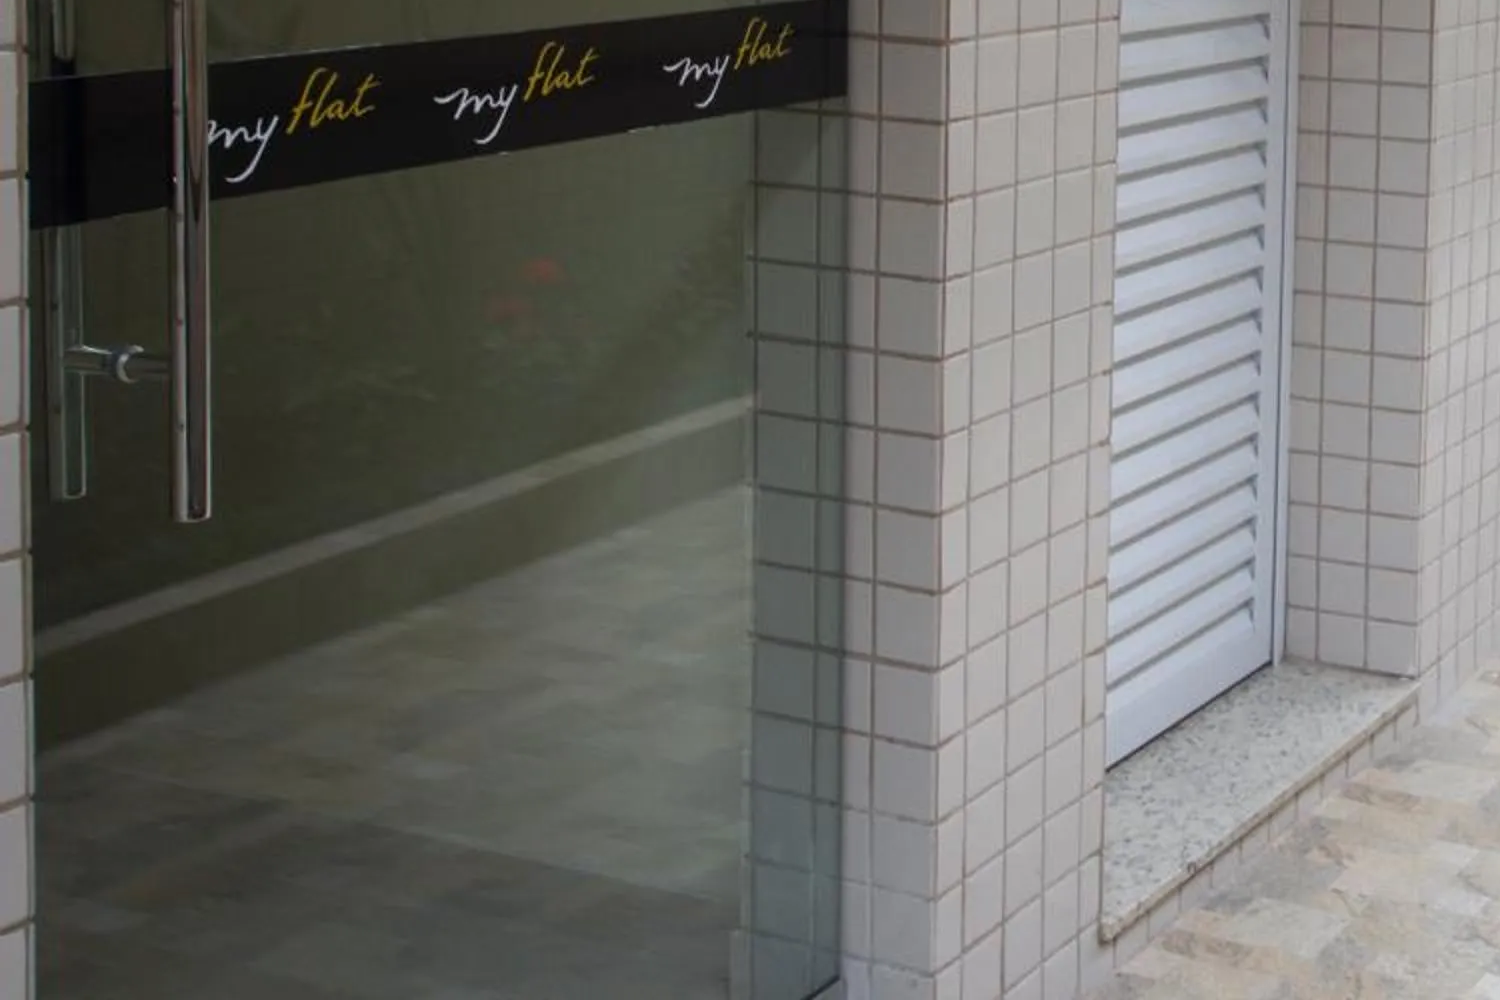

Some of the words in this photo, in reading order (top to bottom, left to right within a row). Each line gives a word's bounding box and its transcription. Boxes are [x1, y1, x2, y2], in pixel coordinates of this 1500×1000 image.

[433, 83, 519, 145] my
[523, 41, 599, 102] flat
[664, 55, 730, 109] my
[734, 17, 795, 70] flat
[207, 115, 280, 184] my
[285, 67, 382, 135] flat
